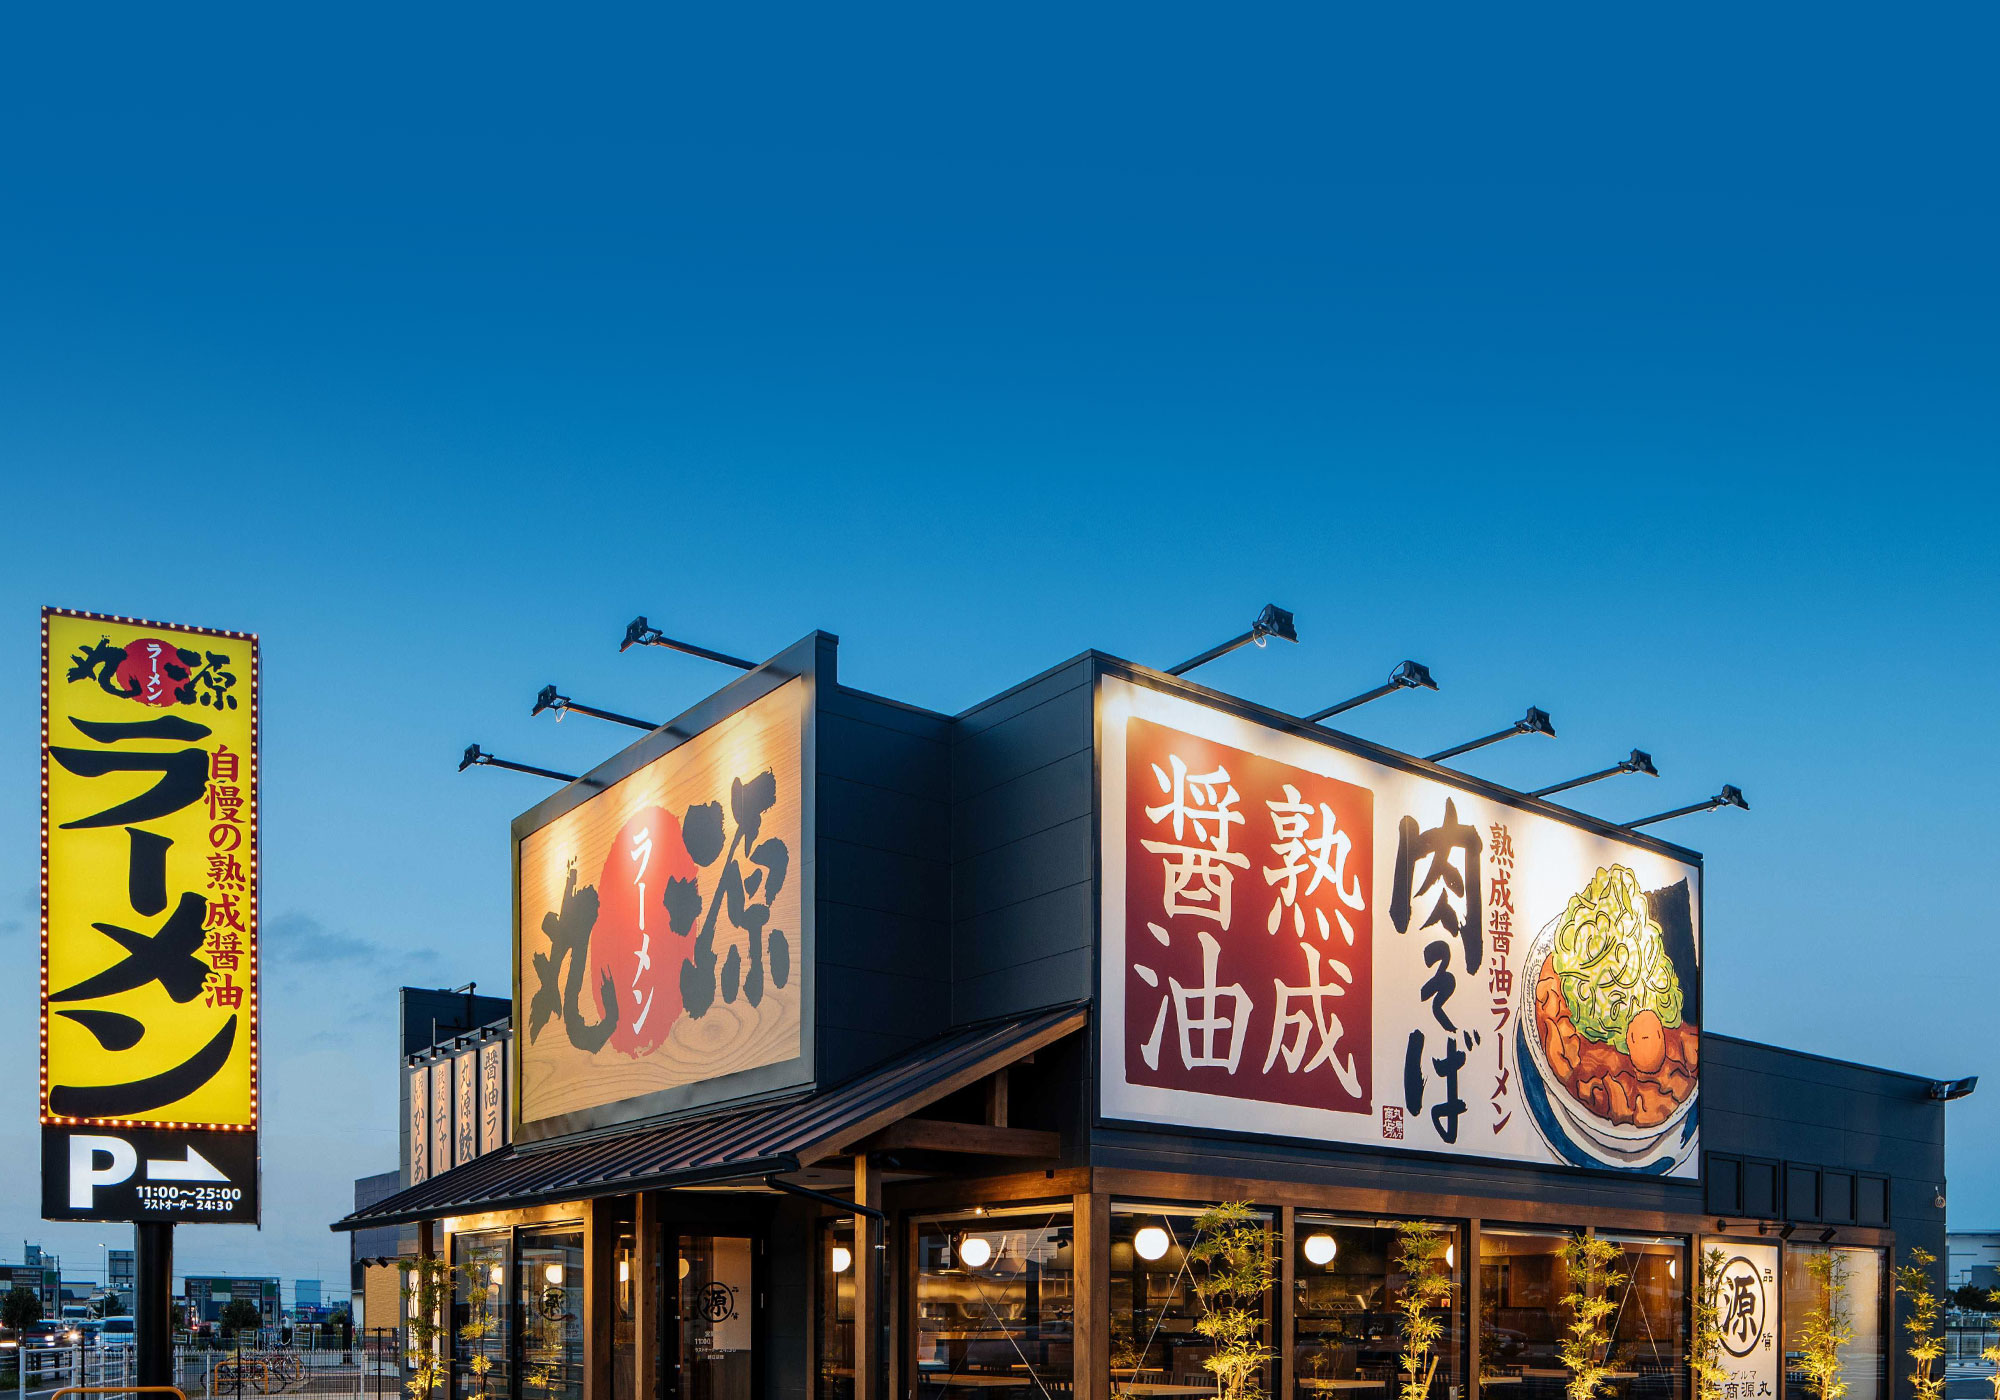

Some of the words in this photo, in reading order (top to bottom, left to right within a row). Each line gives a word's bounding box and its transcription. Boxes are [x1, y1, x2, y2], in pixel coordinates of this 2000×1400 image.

[147, 643, 162, 701] ラーメン
[48, 714, 238, 1118] ラーメン
[203, 744, 247, 1010] 自慢の熟成醤油
[630, 826, 655, 1036] ラーメン
[1133, 754, 1255, 1076] 醤油
[1262, 783, 1366, 1099] 熟成
[1389, 796, 1484, 1144] 肉そば
[1488, 821, 1516, 1135] 熟成醤油ラーメン
[69, 1134, 138, 1209] P
[143, 1199, 194, 1211] ラストオーダー
[196, 1200, 233, 1211] 24:30
[703, 1289, 728, 1317] 源
[1722, 1275, 1758, 1343] 源
